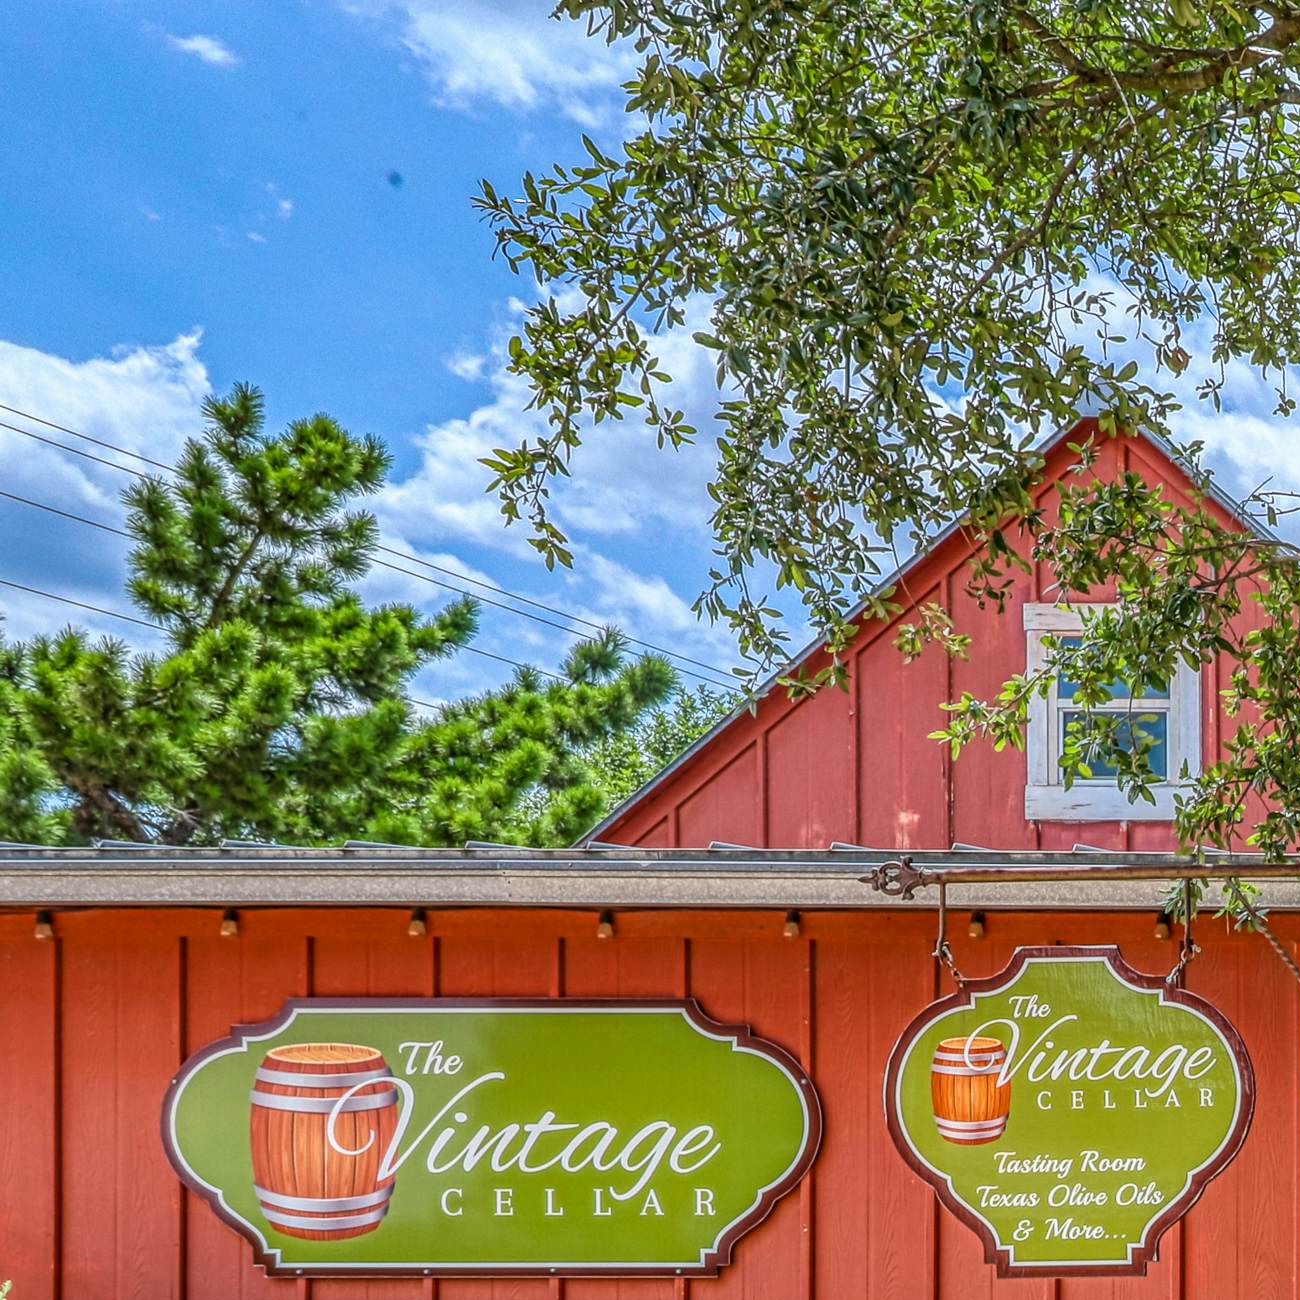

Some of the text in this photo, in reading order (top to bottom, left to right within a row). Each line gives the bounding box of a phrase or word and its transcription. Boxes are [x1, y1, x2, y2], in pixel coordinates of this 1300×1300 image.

[1008, 994, 1051, 1018] The
[398, 1040, 464, 1075] The
[963, 1014, 1217, 1098] Vintage
[1036, 1088, 1215, 1110] CELLAR
[326, 1071, 722, 1201] Vintage
[993, 1150, 1146, 1179] Tasting Room
[441, 1188, 717, 1217] CELLAR
[975, 1182, 1165, 1208] Texas Olive Oils
[1012, 1217, 1128, 1242] & More...
